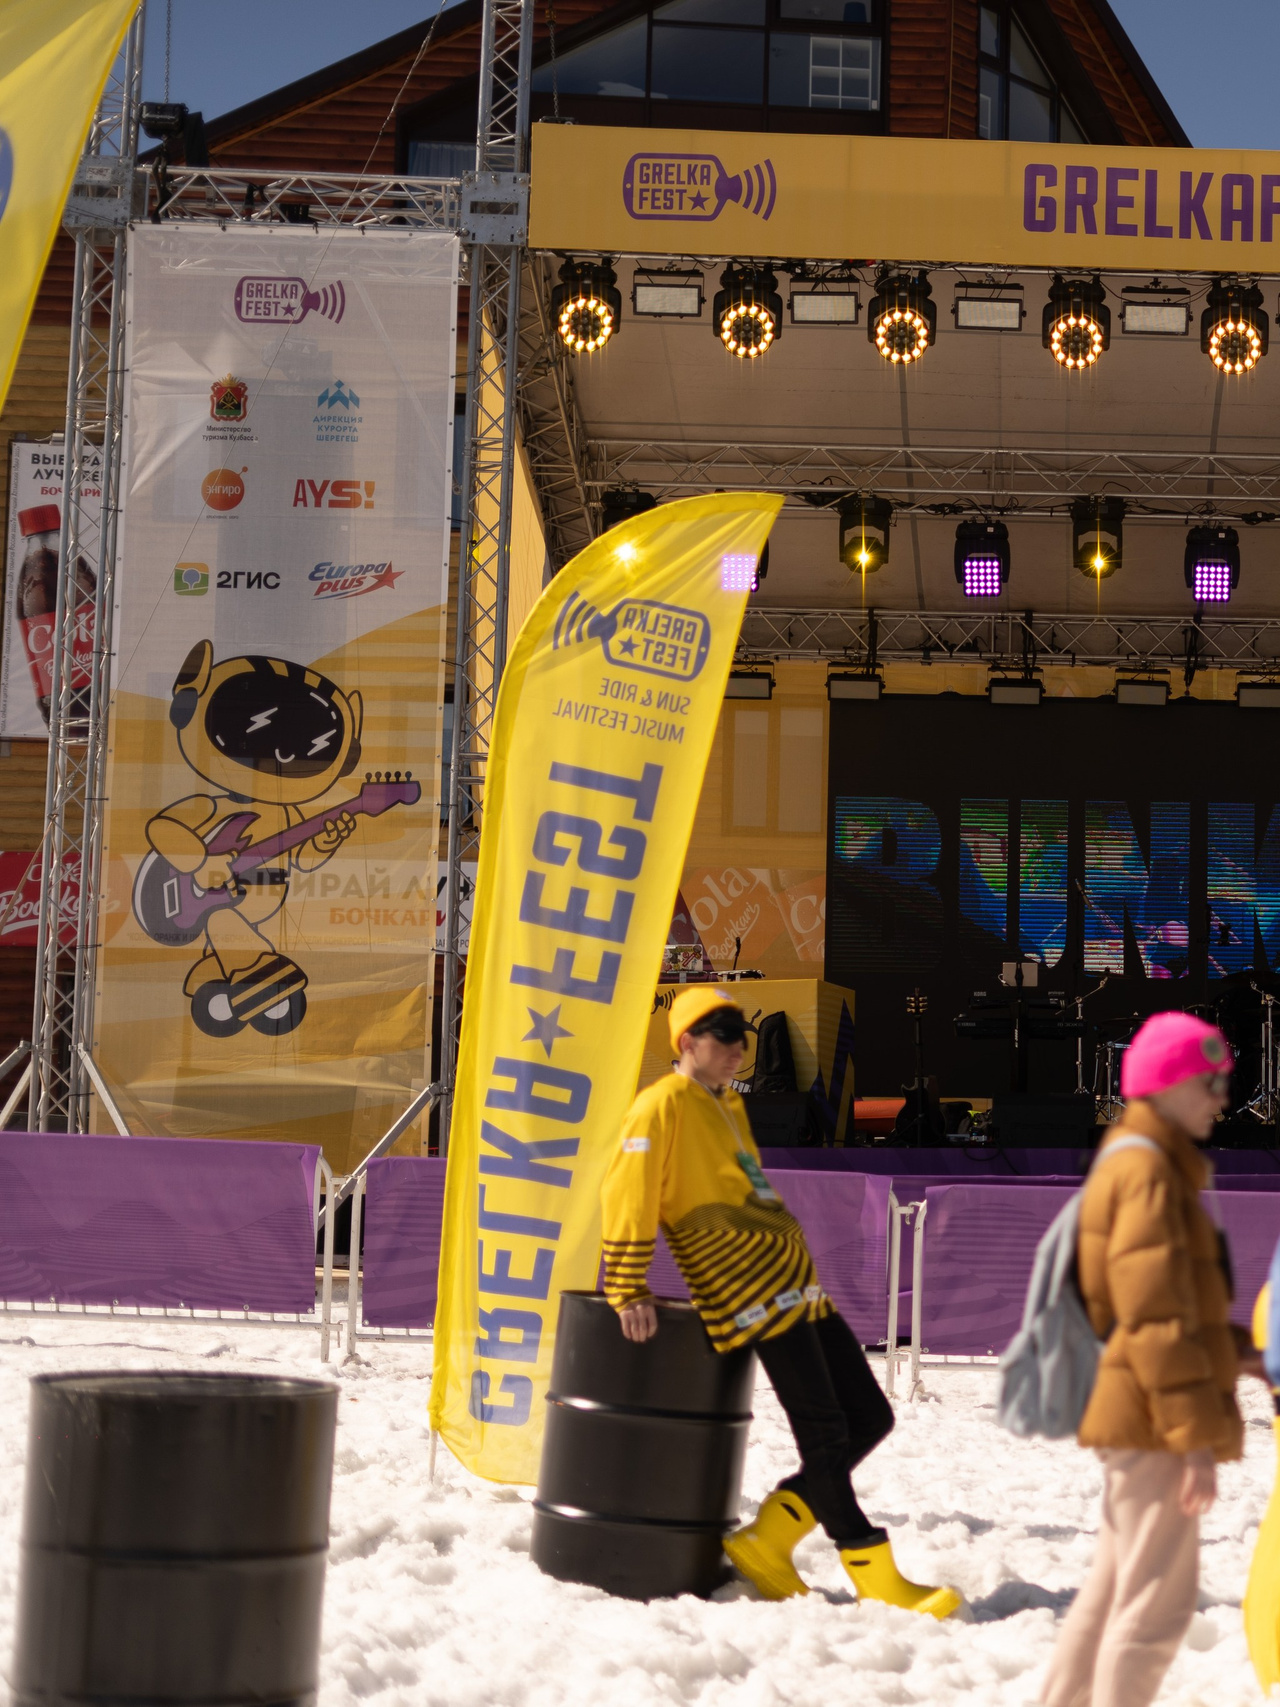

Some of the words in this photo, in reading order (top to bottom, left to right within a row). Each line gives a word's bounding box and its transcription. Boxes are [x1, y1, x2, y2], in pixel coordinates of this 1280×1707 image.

[639, 163, 711, 186] GRELKA
[638, 188, 687, 210] FEST
[246, 282, 298, 300] GRELKA
[245, 301, 280, 316] FEST
[312, 415, 363, 424] ДИРЕКЦИЯ
[206, 425, 252, 434] Министерство
[317, 425, 358, 433] КУРОРТА
[316, 434, 359, 443] ШЕРЕГЕШ
[206, 485, 241, 497] энгиро
[293, 479, 375, 509] AYS!
[308, 561, 388, 581] Europa
[217, 570, 281, 590] 2ГИС
